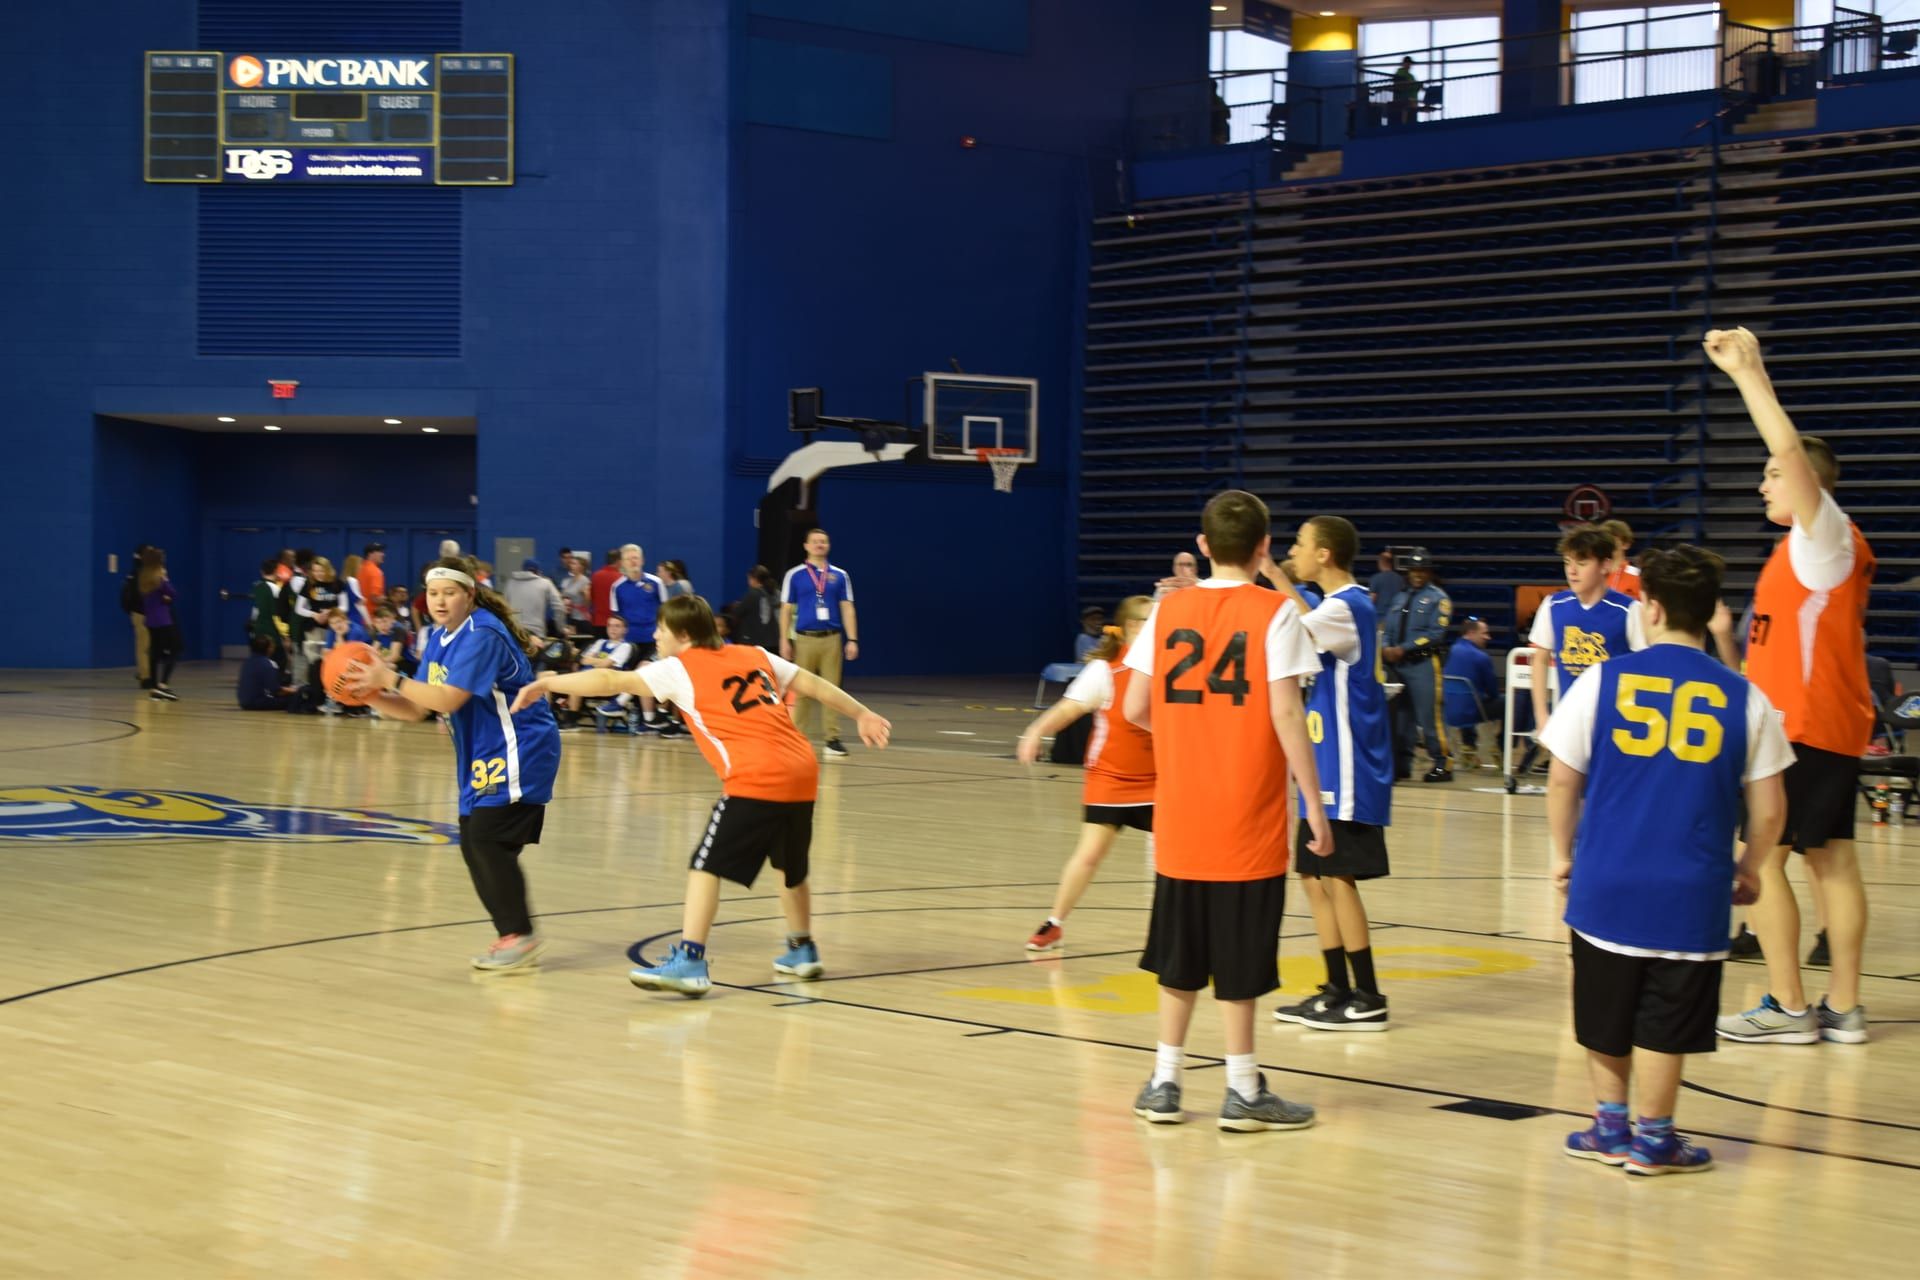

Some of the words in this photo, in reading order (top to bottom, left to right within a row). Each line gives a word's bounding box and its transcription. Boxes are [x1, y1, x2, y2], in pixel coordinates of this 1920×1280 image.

[379, 96, 420, 108] GUEST
[1165, 628, 1251, 706] 24
[722, 668, 779, 714] 23
[1612, 672, 1728, 763] 56
[471, 758, 506, 789] 32
